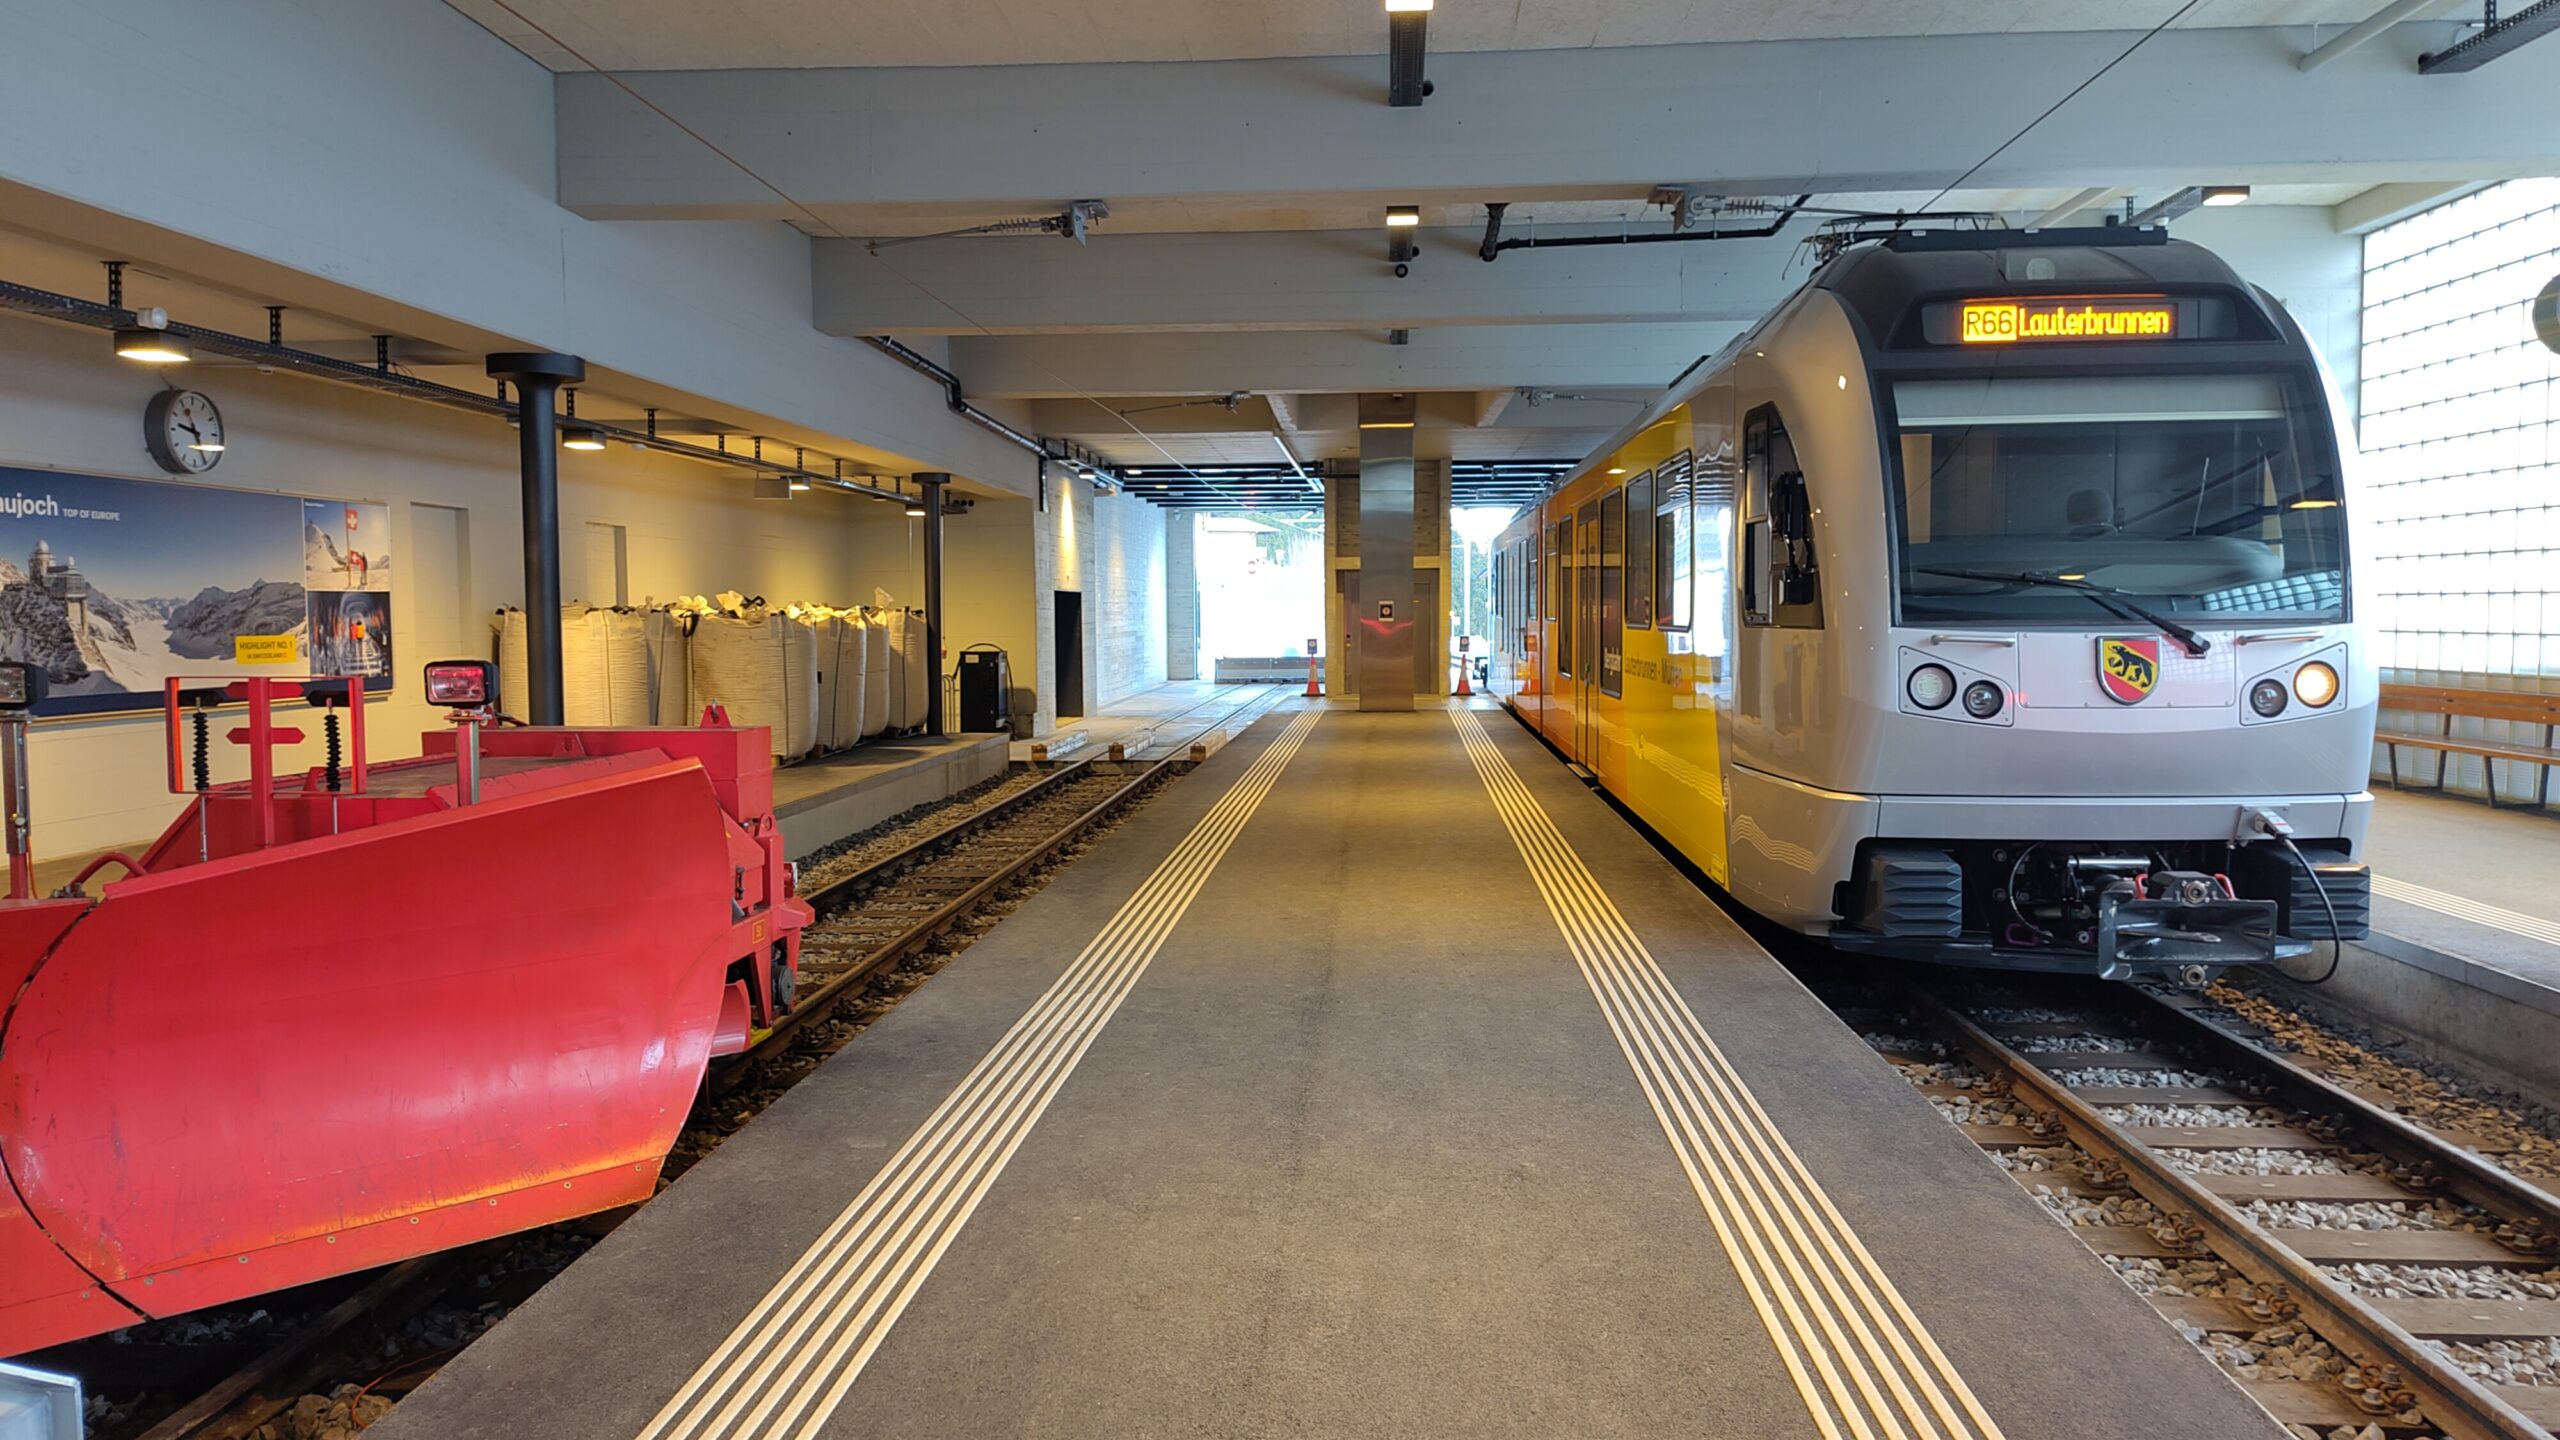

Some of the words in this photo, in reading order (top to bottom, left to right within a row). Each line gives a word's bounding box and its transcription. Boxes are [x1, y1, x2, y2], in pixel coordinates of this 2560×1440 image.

[1966, 310, 2013, 335] R66
[2019, 307, 2169, 336] Lauterbrunnen
[62, 508, 78, 517] TOP
[80, 510, 90, 518] OF
[91, 511, 120, 521] EUROPE
[240, 641, 276, 649] HIGHLIGHT
